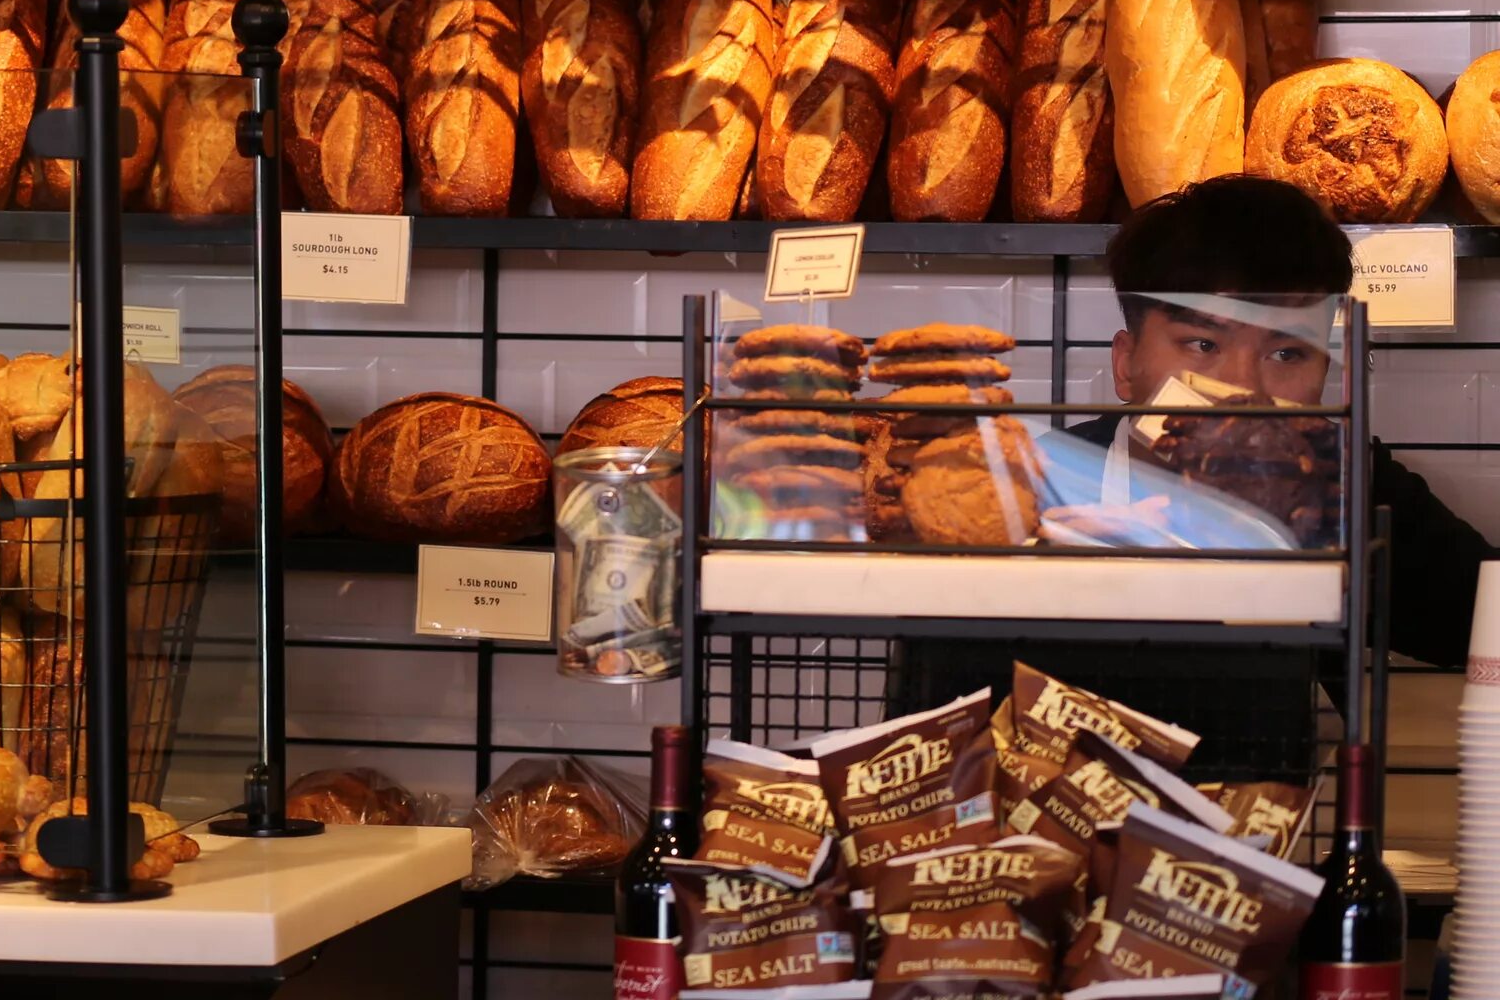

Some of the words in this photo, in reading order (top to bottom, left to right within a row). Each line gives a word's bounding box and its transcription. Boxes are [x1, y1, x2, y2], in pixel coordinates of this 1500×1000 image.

[292, 244, 350, 254] SOURDOUGH
[352, 246, 378, 256] LONG
[329, 234, 343, 242] 1lb
[322, 264, 348, 274] $4.15
[1353, 265, 1377, 274] RLIC
[1380, 264, 1428, 274] VOLCANO
[1368, 284, 1396, 293] $5.99
[458, 578, 481, 587] 1.5lb
[484, 580, 518, 590] ROUND
[474, 596, 500, 606] $5.79
[841, 733, 954, 800] KETTLE
[848, 801, 909, 829] POTATO
[911, 785, 956, 812] CHIPS
[1044, 796, 1094, 841] POTATO
[723, 822, 767, 848] SEA
[771, 837, 817, 862] SAL
[859, 839, 898, 868] SEA
[901, 823, 955, 852] SALT
[908, 850, 1038, 887] KETTLE
[910, 895, 975, 911] POTATO
[977, 887, 1024, 903] CHIPS
[1132, 848, 1263, 935] KETTLE
[708, 924, 768, 948] POTATO
[770, 914, 818, 935] CHIPS
[908, 922, 954, 941] SEA
[959, 920, 1020, 941] SALT
[1124, 908, 1190, 947] POTATO
[1191, 937, 1240, 968] CHIPS
[714, 967, 756, 989] SEA
[760, 953, 817, 980] SALT
[1111, 947, 1154, 979] SEA
